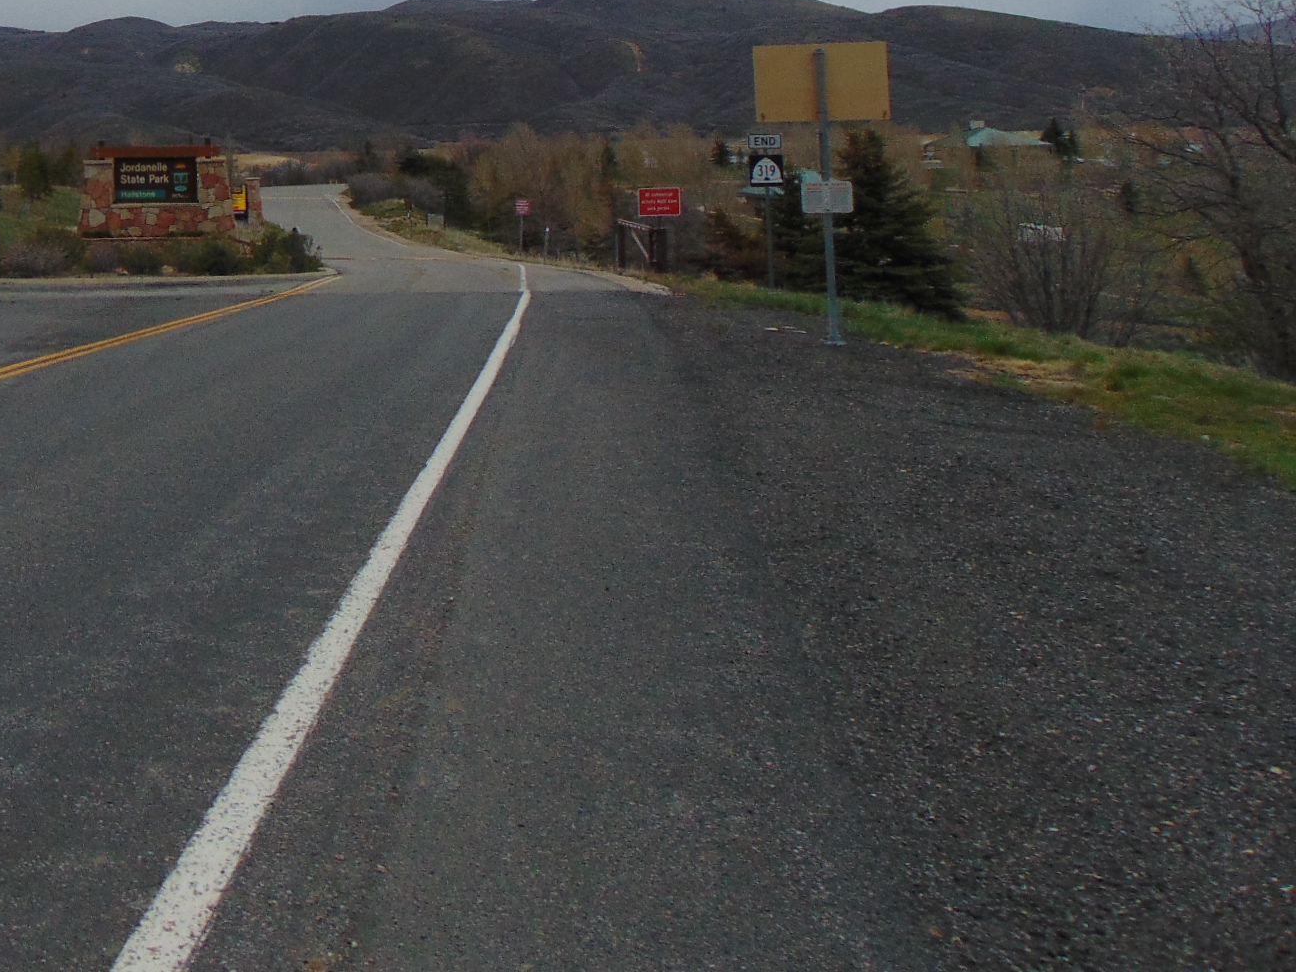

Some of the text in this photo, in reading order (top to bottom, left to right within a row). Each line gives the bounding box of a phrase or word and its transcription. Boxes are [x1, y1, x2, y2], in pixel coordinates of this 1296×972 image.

[754, 136, 776, 146] END
[120, 162, 168, 172] Jordanelle
[757, 164, 776, 177] 319
[120, 174, 170, 184] State Park
